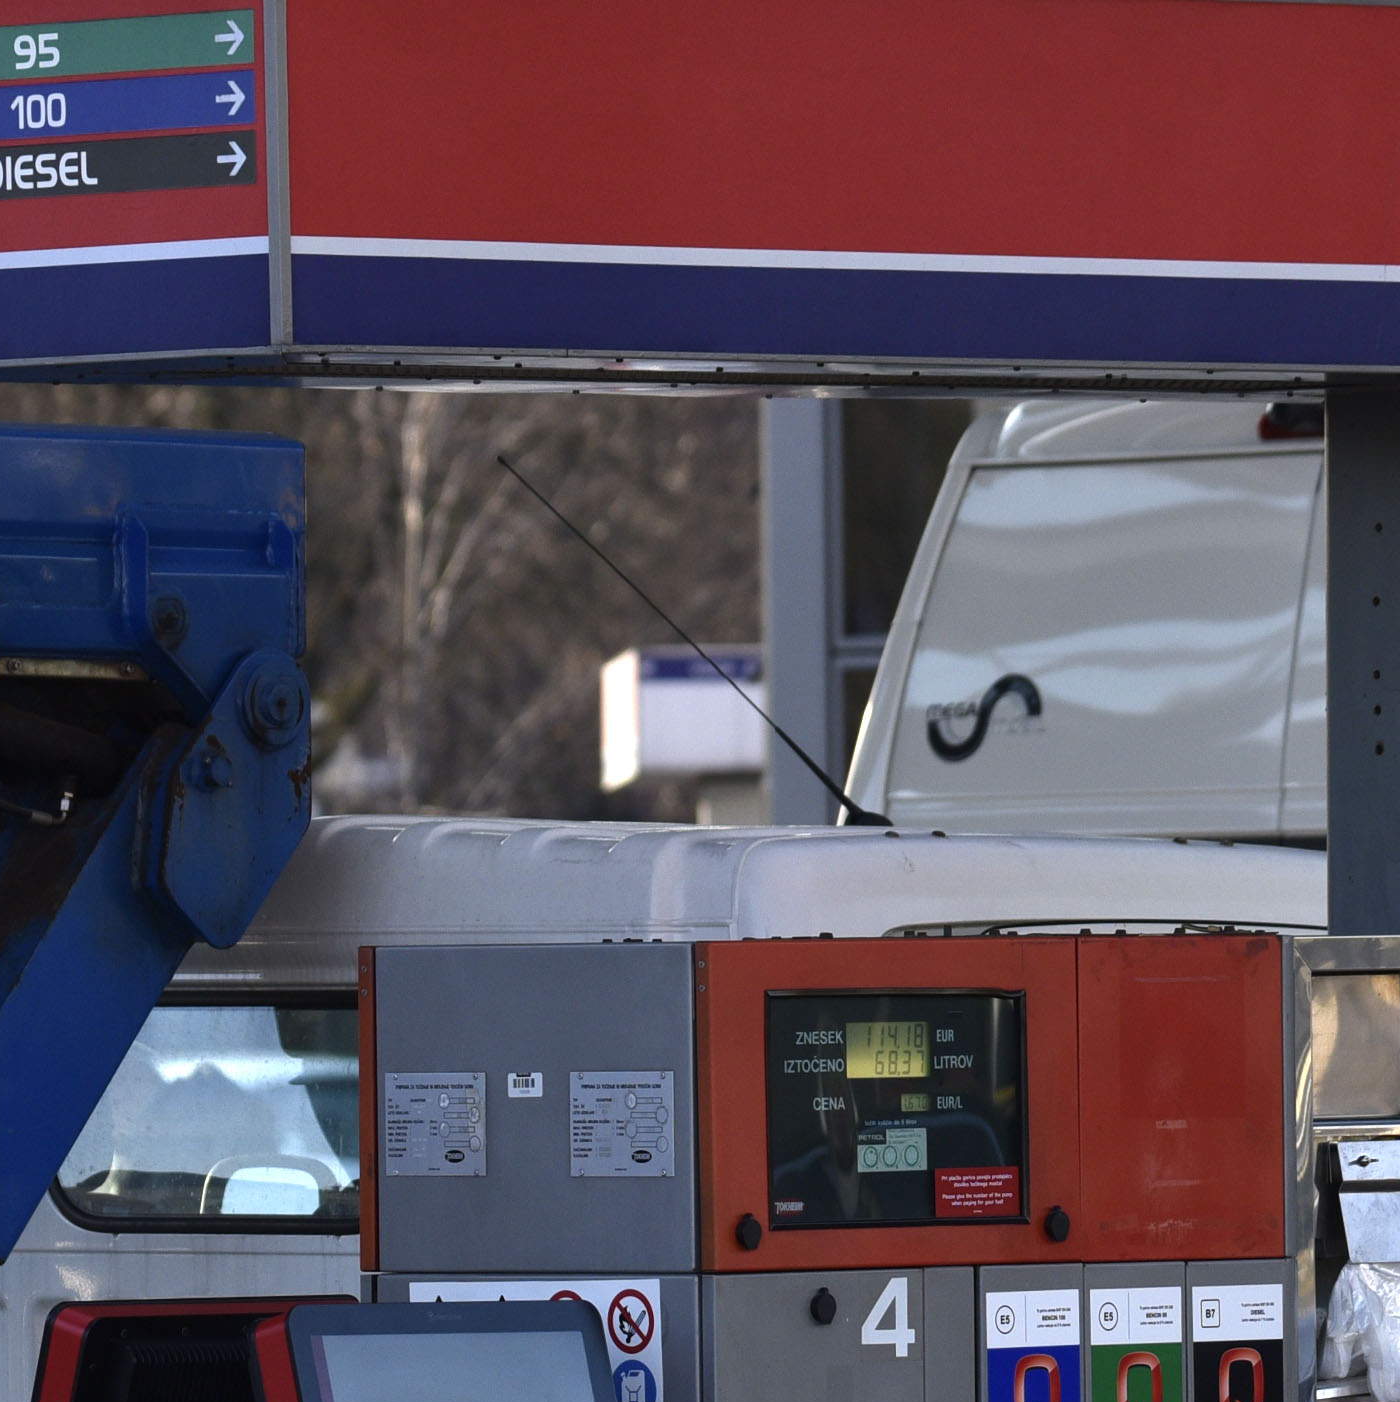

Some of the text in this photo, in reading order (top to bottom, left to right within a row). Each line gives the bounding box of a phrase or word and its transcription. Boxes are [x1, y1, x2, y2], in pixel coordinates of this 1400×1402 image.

[13, 32, 60, 71] 95
[10, 92, 67, 130] 100
[795, 1030, 844, 1046] ZNESEK
[936, 1029, 954, 1043] EUR
[784, 1055, 845, 1074] IZTOČENO
[934, 1054, 974, 1070] LITROV
[813, 1096, 846, 1111] CENA
[936, 1096, 963, 1110] EUR/L
[861, 1277, 916, 1357] 4
[1000, 1315, 1010, 1325] E5
[1104, 1312, 1114, 1321] E5
[1205, 1309, 1216, 1318] B7
